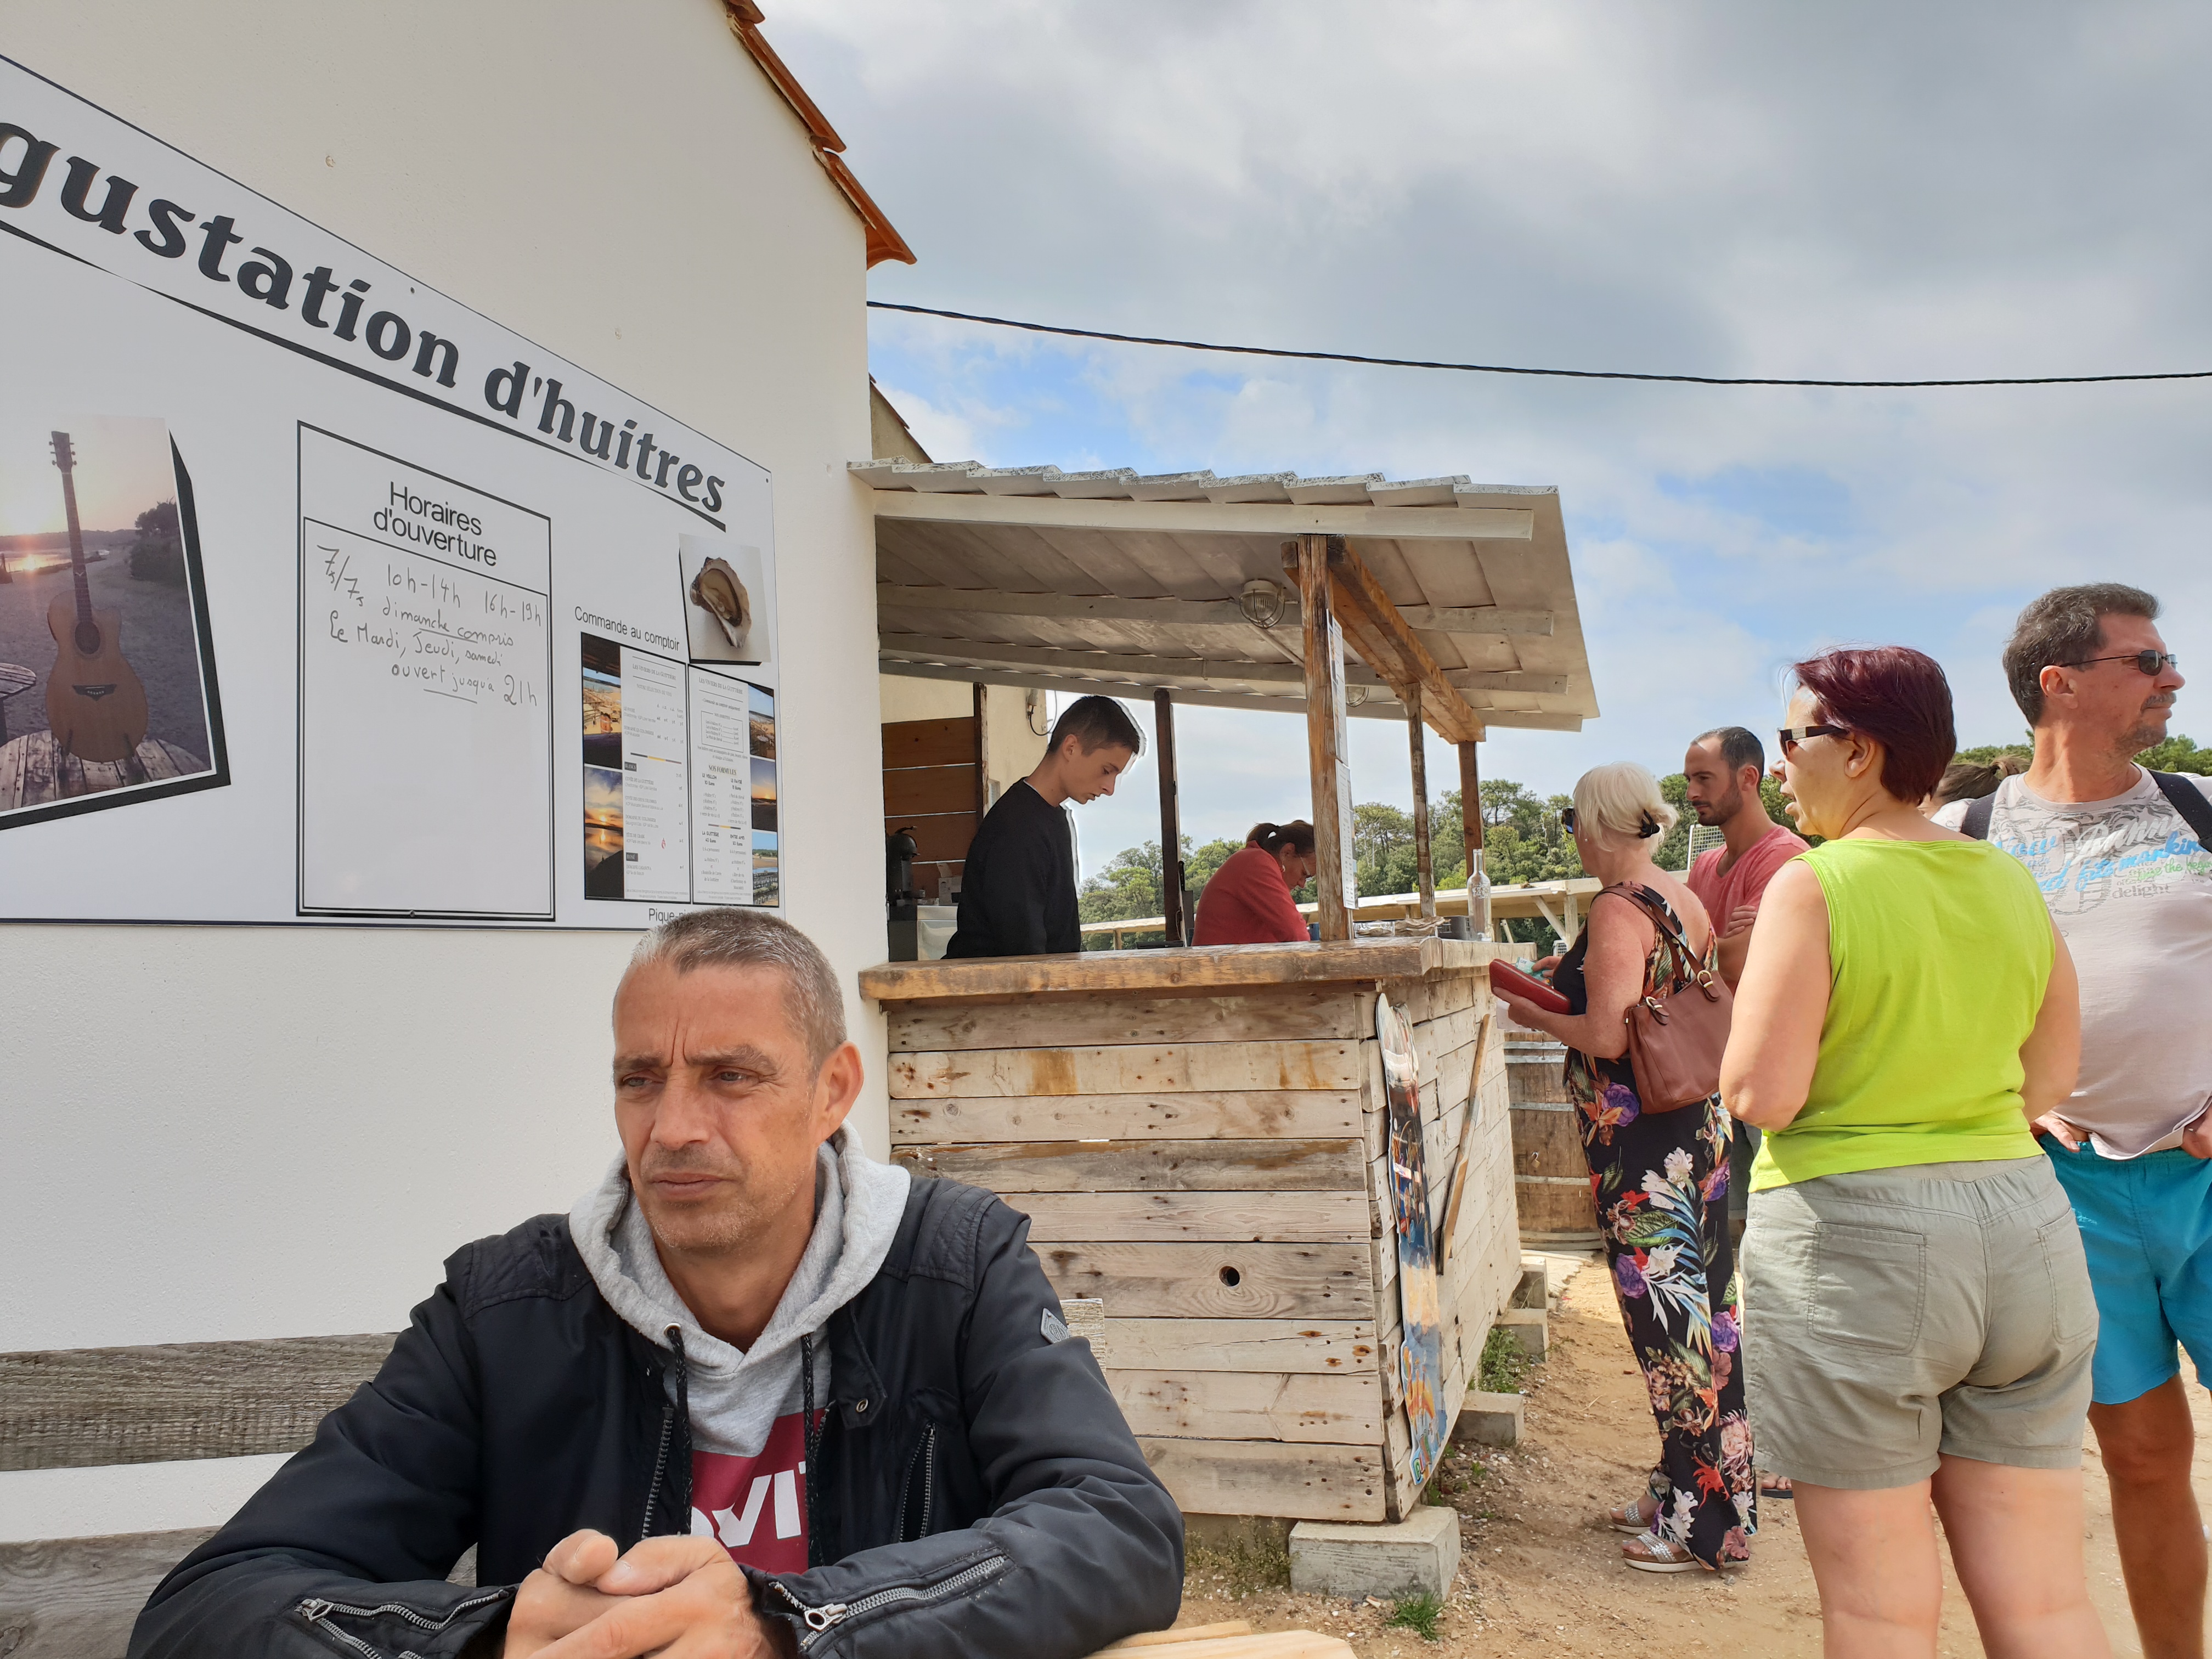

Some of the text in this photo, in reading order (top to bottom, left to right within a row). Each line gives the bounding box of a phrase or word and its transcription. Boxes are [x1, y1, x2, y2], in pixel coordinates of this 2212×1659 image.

[390, 481, 482, 536] Horaires
[373, 507, 498, 567] d'ouverture
[382, 596, 515, 646] dimanche compris
[574, 606, 680, 652] Commande au comptoir
[391, 664, 446, 684] ouvert
[2112, 883, 2171, 899] delight
